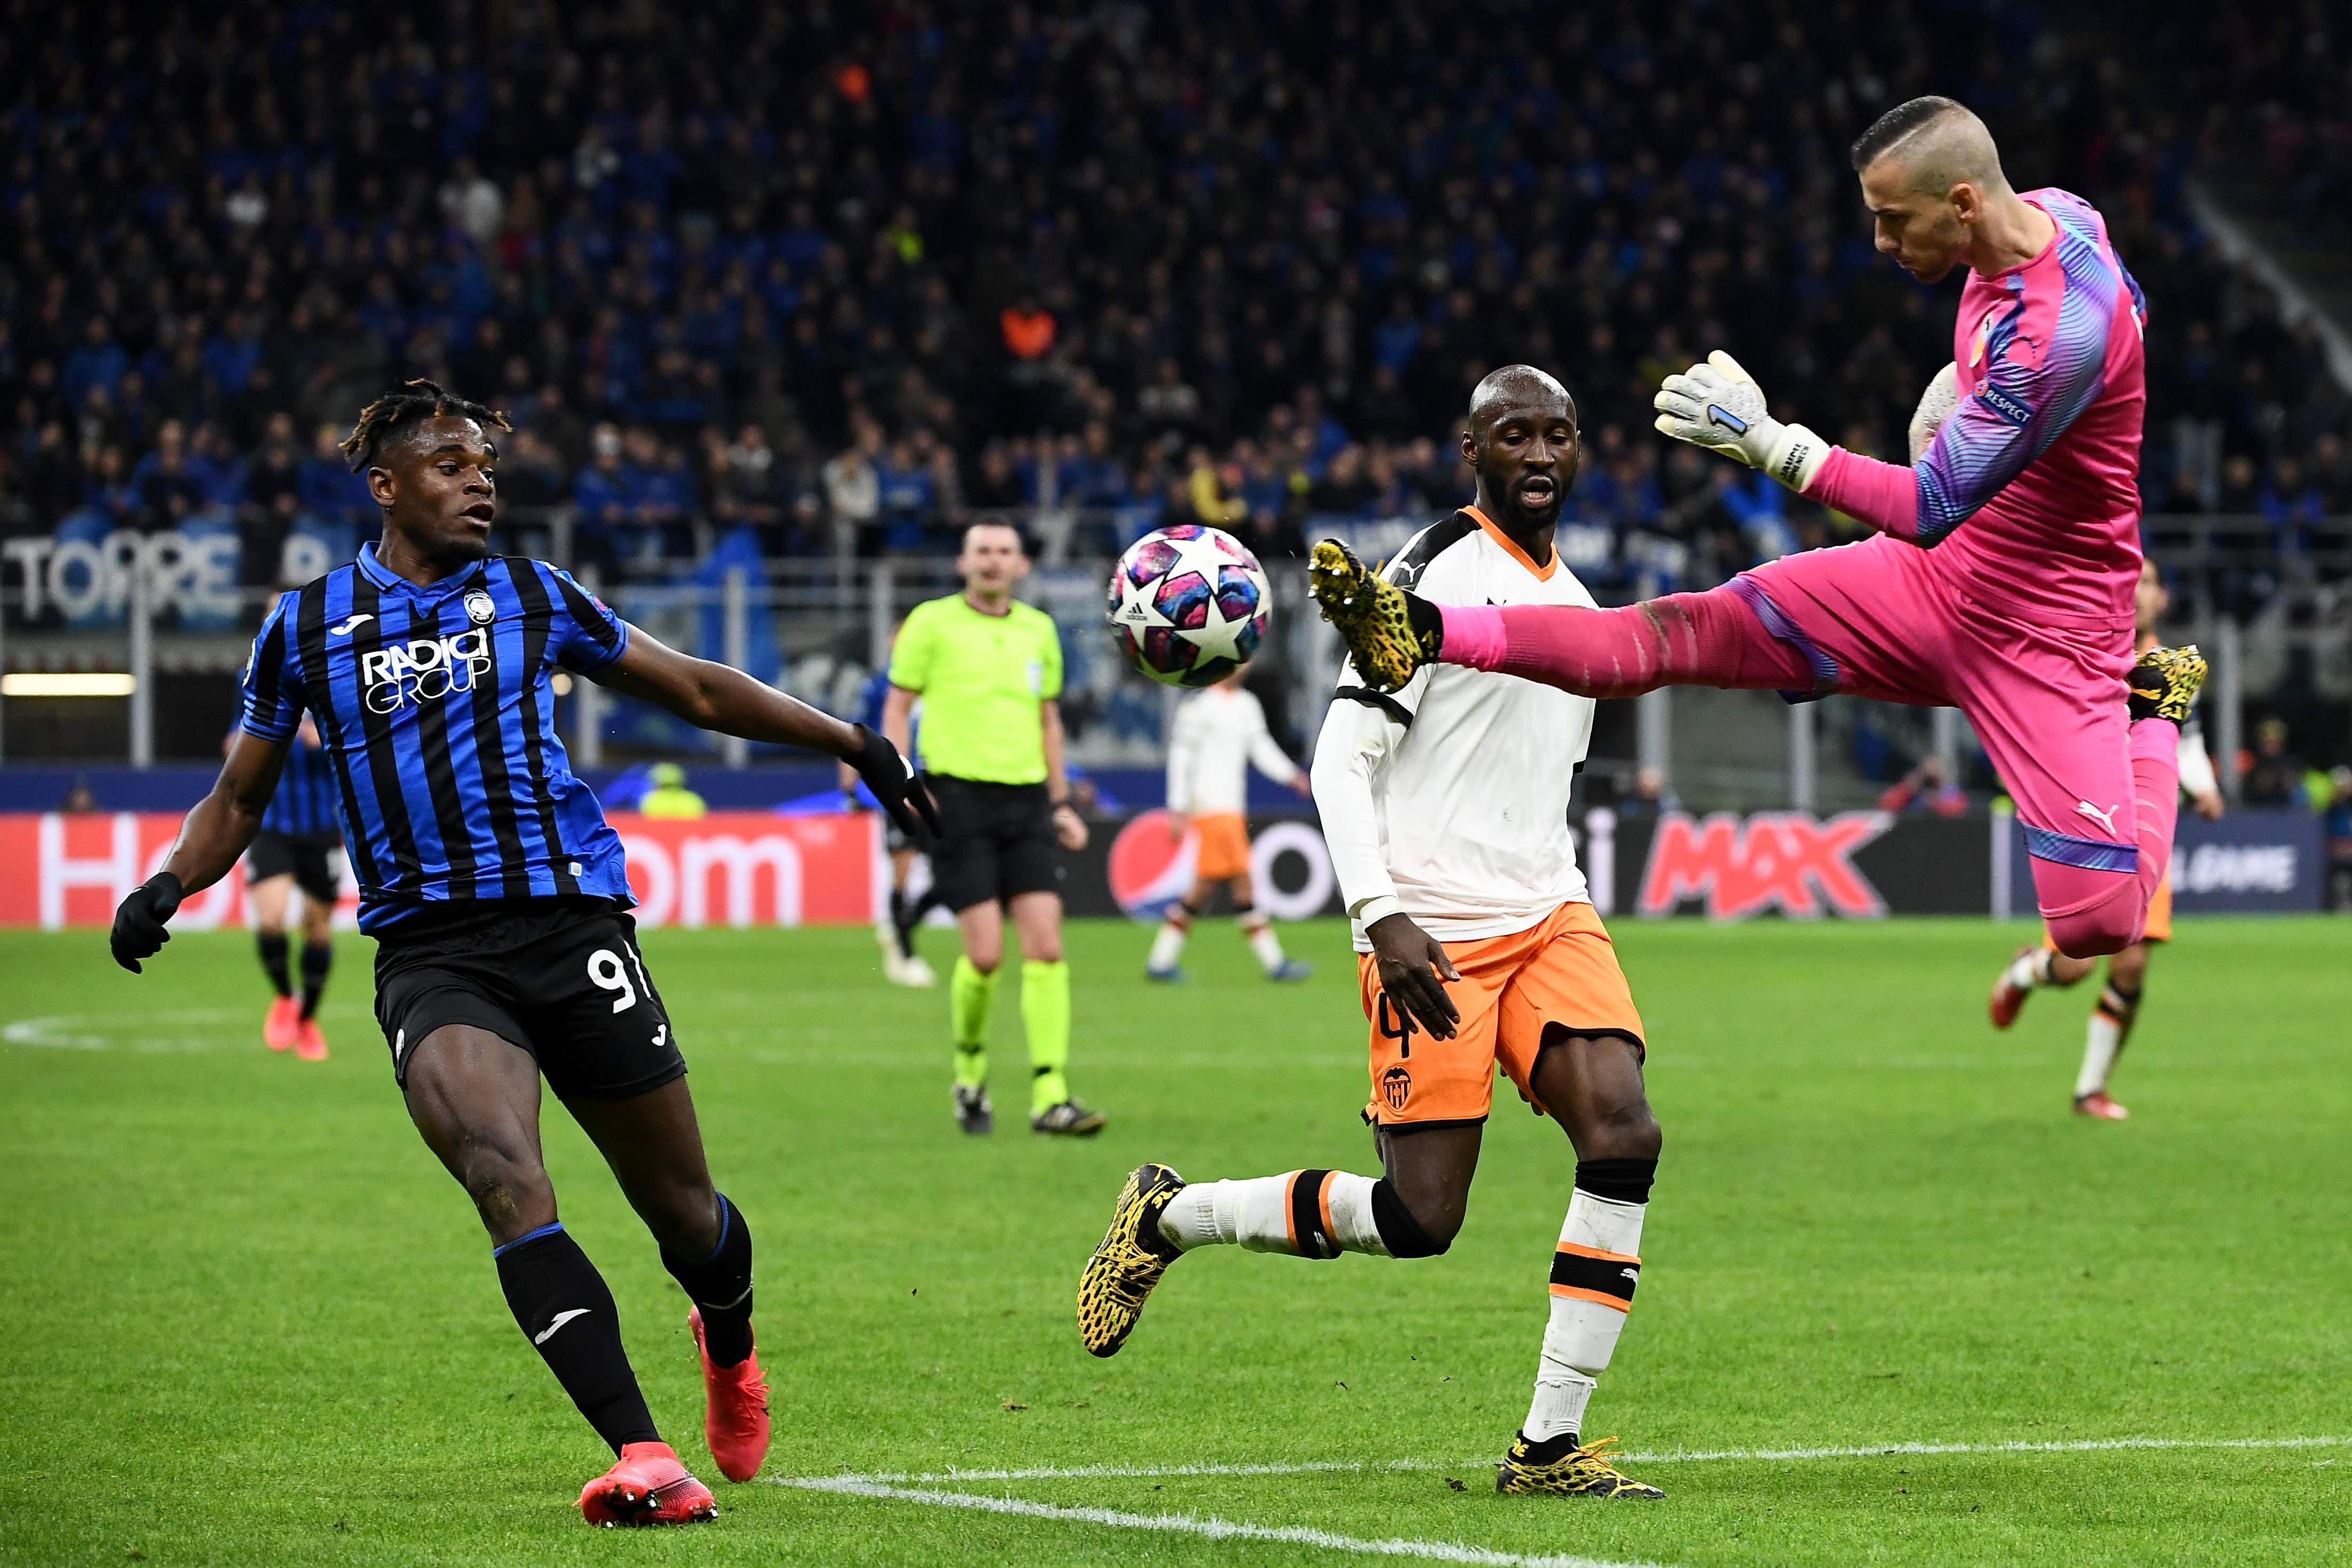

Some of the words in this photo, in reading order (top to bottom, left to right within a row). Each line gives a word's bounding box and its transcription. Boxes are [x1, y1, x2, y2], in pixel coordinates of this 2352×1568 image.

[1707, 404, 1747, 435] 1
[1984, 390, 2031, 422] RESPECT
[366, 657, 491, 714] GROUP
[1636, 810, 1898, 923] MAX
[588, 939, 652, 1014] 91
[1379, 992, 1410, 1059] 4
